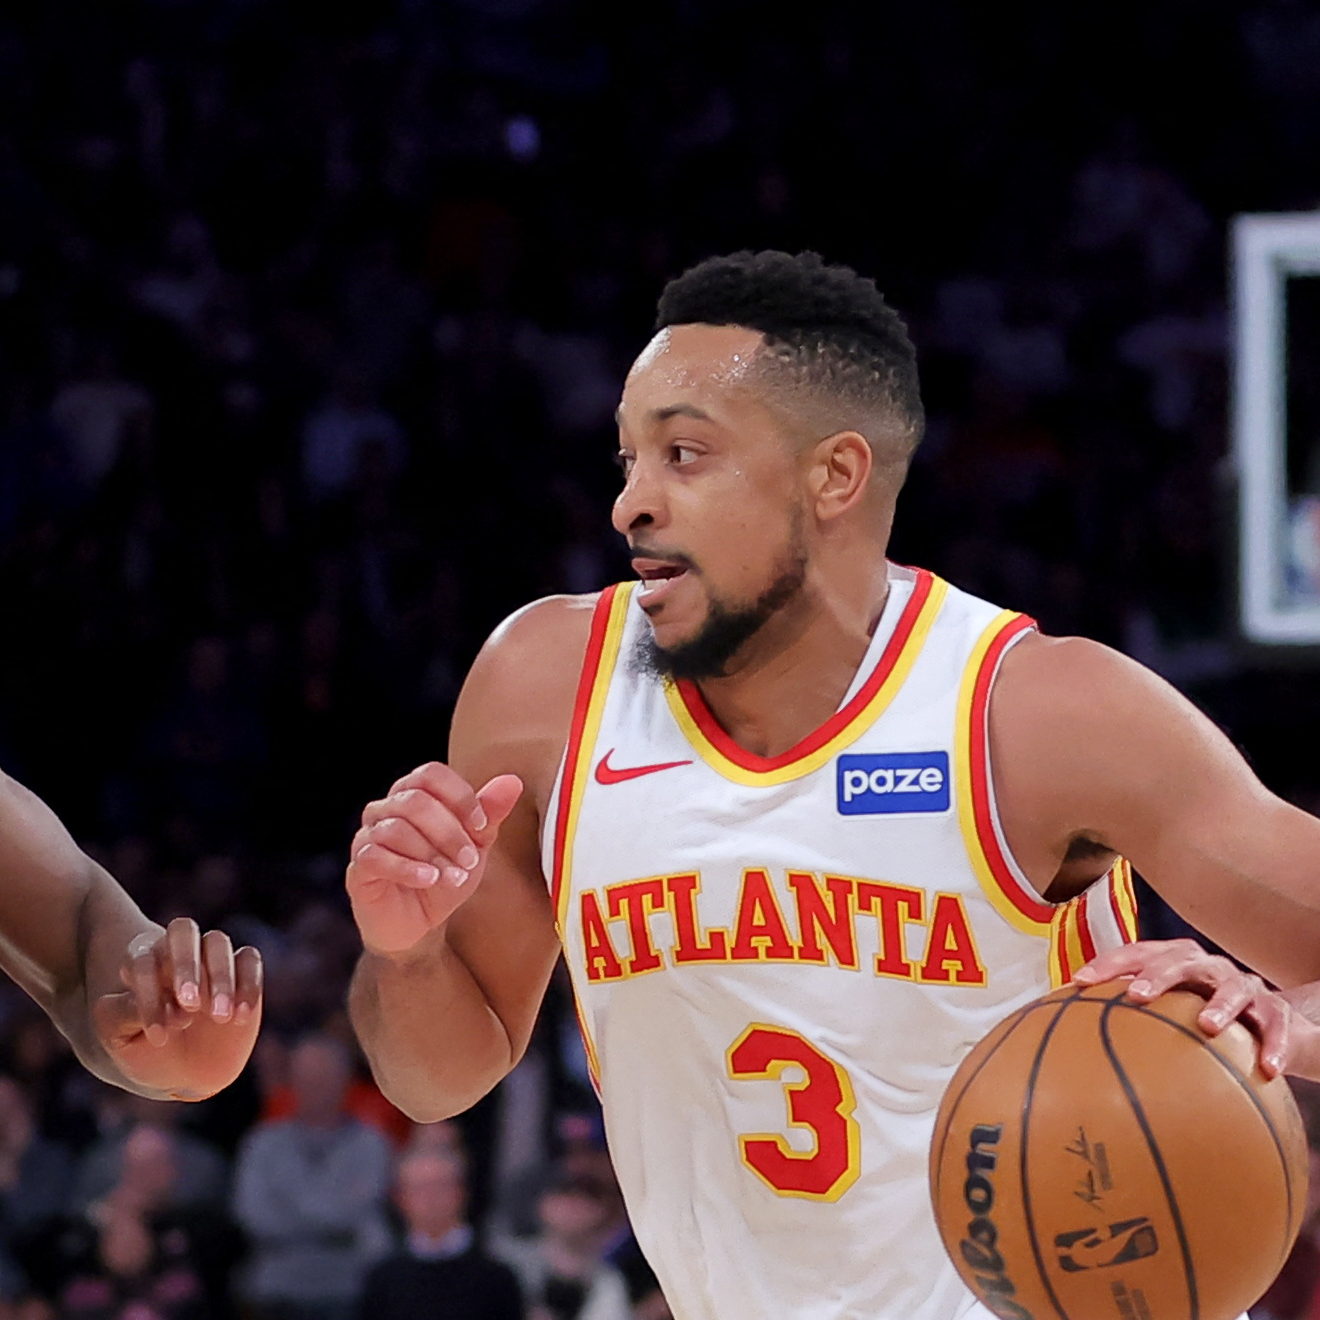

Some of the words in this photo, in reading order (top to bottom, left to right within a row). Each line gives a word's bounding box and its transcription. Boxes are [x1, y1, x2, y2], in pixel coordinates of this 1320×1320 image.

[843, 766, 944, 803] paze
[580, 867, 987, 986] ATLANTA
[726, 1022, 861, 1202] 3
